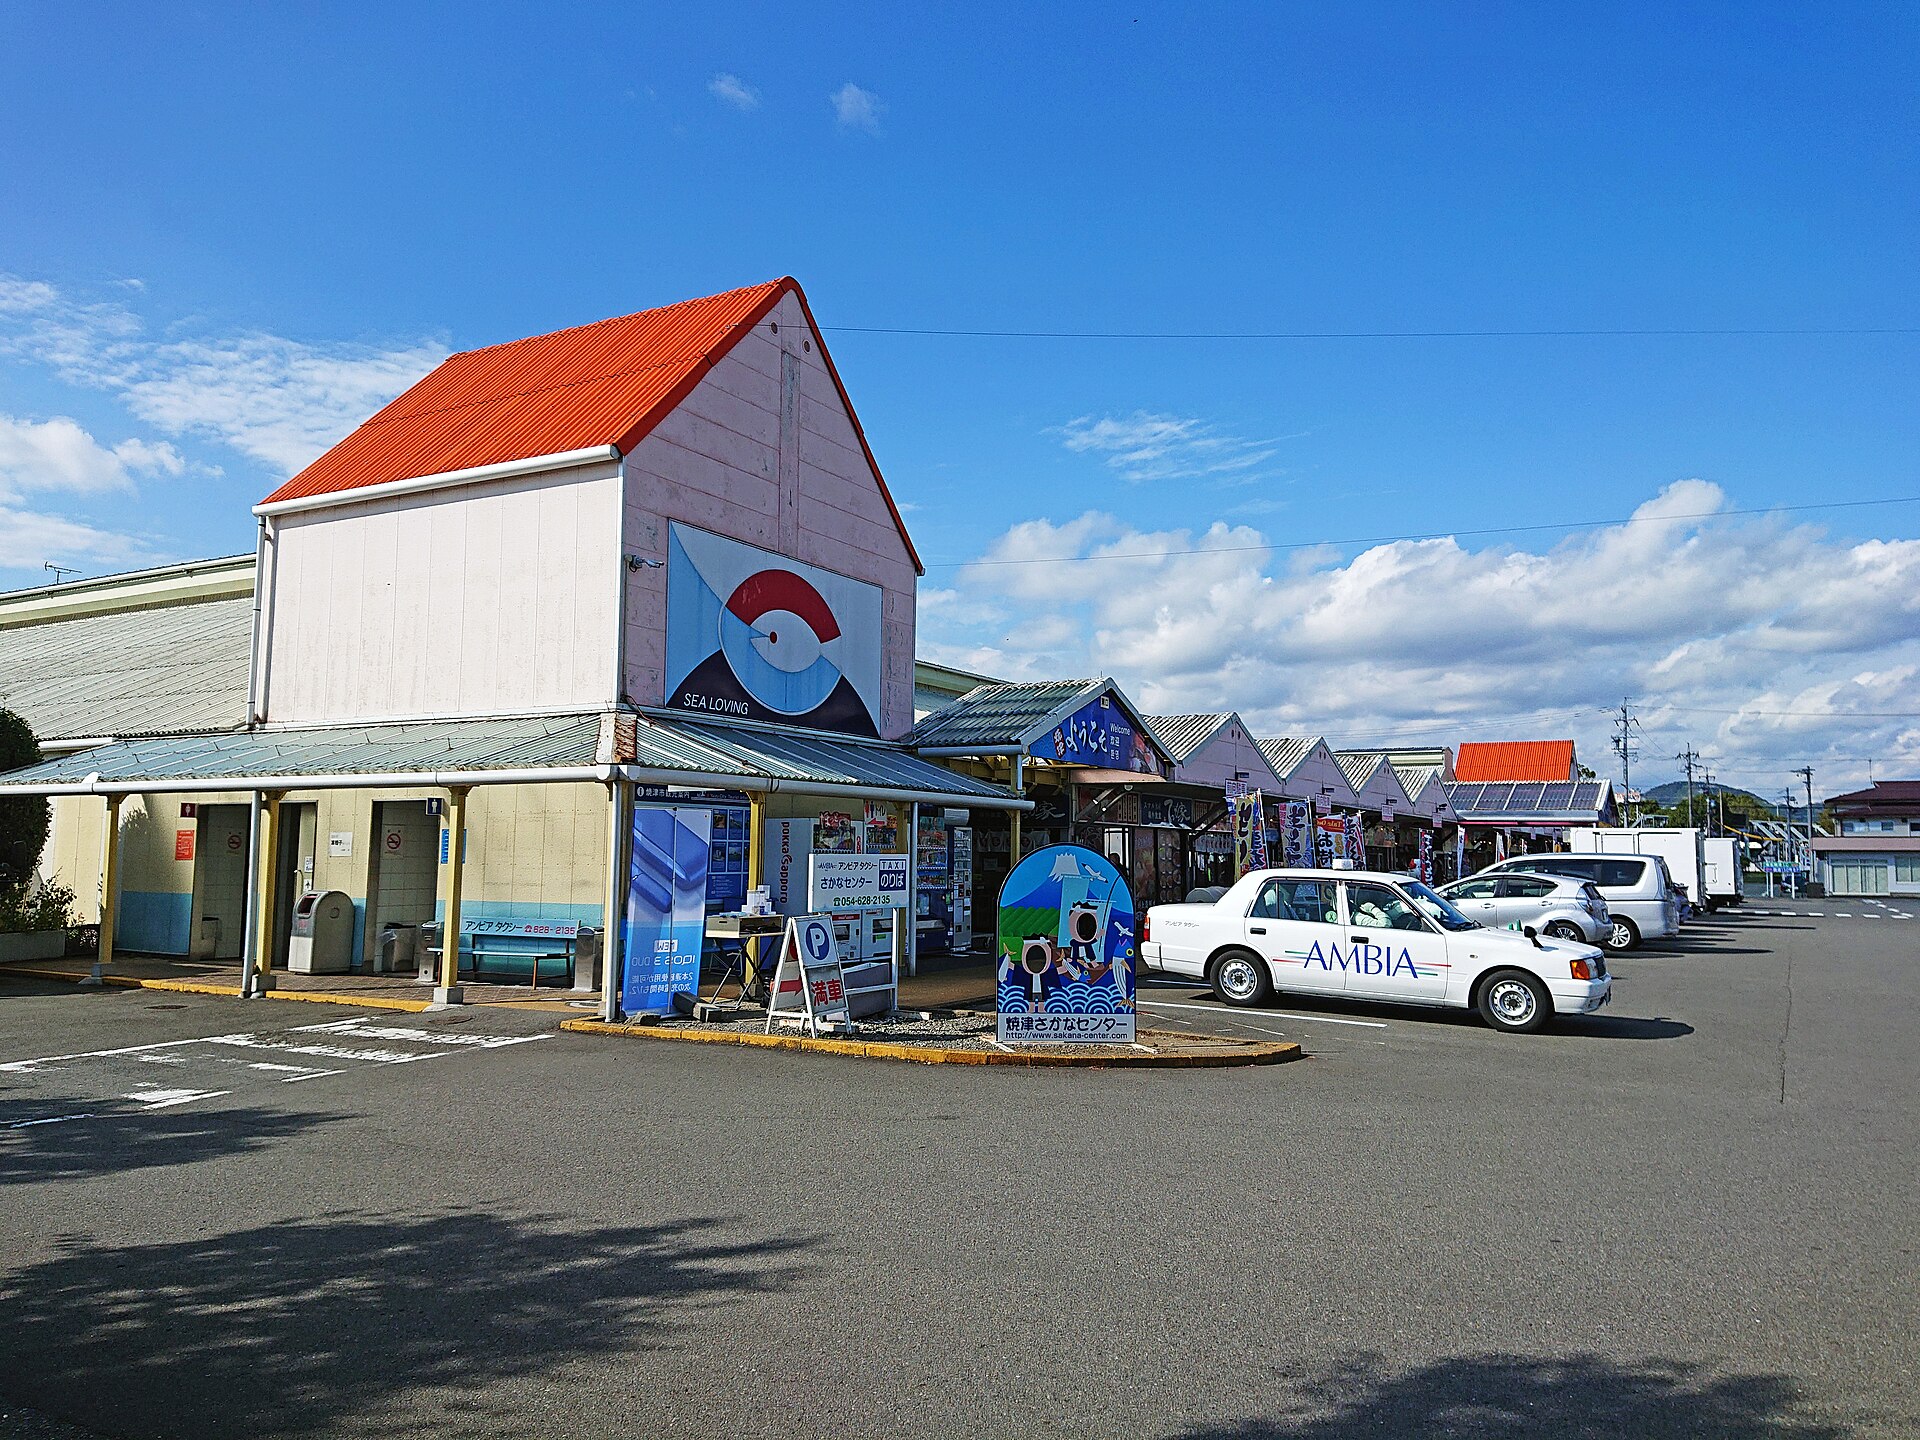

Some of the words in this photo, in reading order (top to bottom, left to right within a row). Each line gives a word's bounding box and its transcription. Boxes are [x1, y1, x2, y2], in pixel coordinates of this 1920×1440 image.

[683, 693, 707, 709] SEA
[709, 697, 749, 715] LOVING
[1065, 716, 1108, 753] ようこそ
[1110, 722, 1130, 736] Welcome
[780, 822, 790, 856] pokka
[838, 861, 858, 871] アンビア
[860, 862, 878, 871] タクシー
[881, 861, 904, 870] TAXI
[820, 877, 873, 890] さかなセンター
[880, 873, 905, 888] のりば
[841, 895, 891, 906] 054-628-2135
[465, 920, 494, 932] アンビア
[495, 921, 523, 932] タクシー
[1304, 940, 1419, 979] AMBIA
[810, 978, 844, 1007] 満車
[1005, 1016, 1128, 1032] 焼津さかなセンター
[1005, 1031, 1128, 1040] http://www.sakana-center.com
